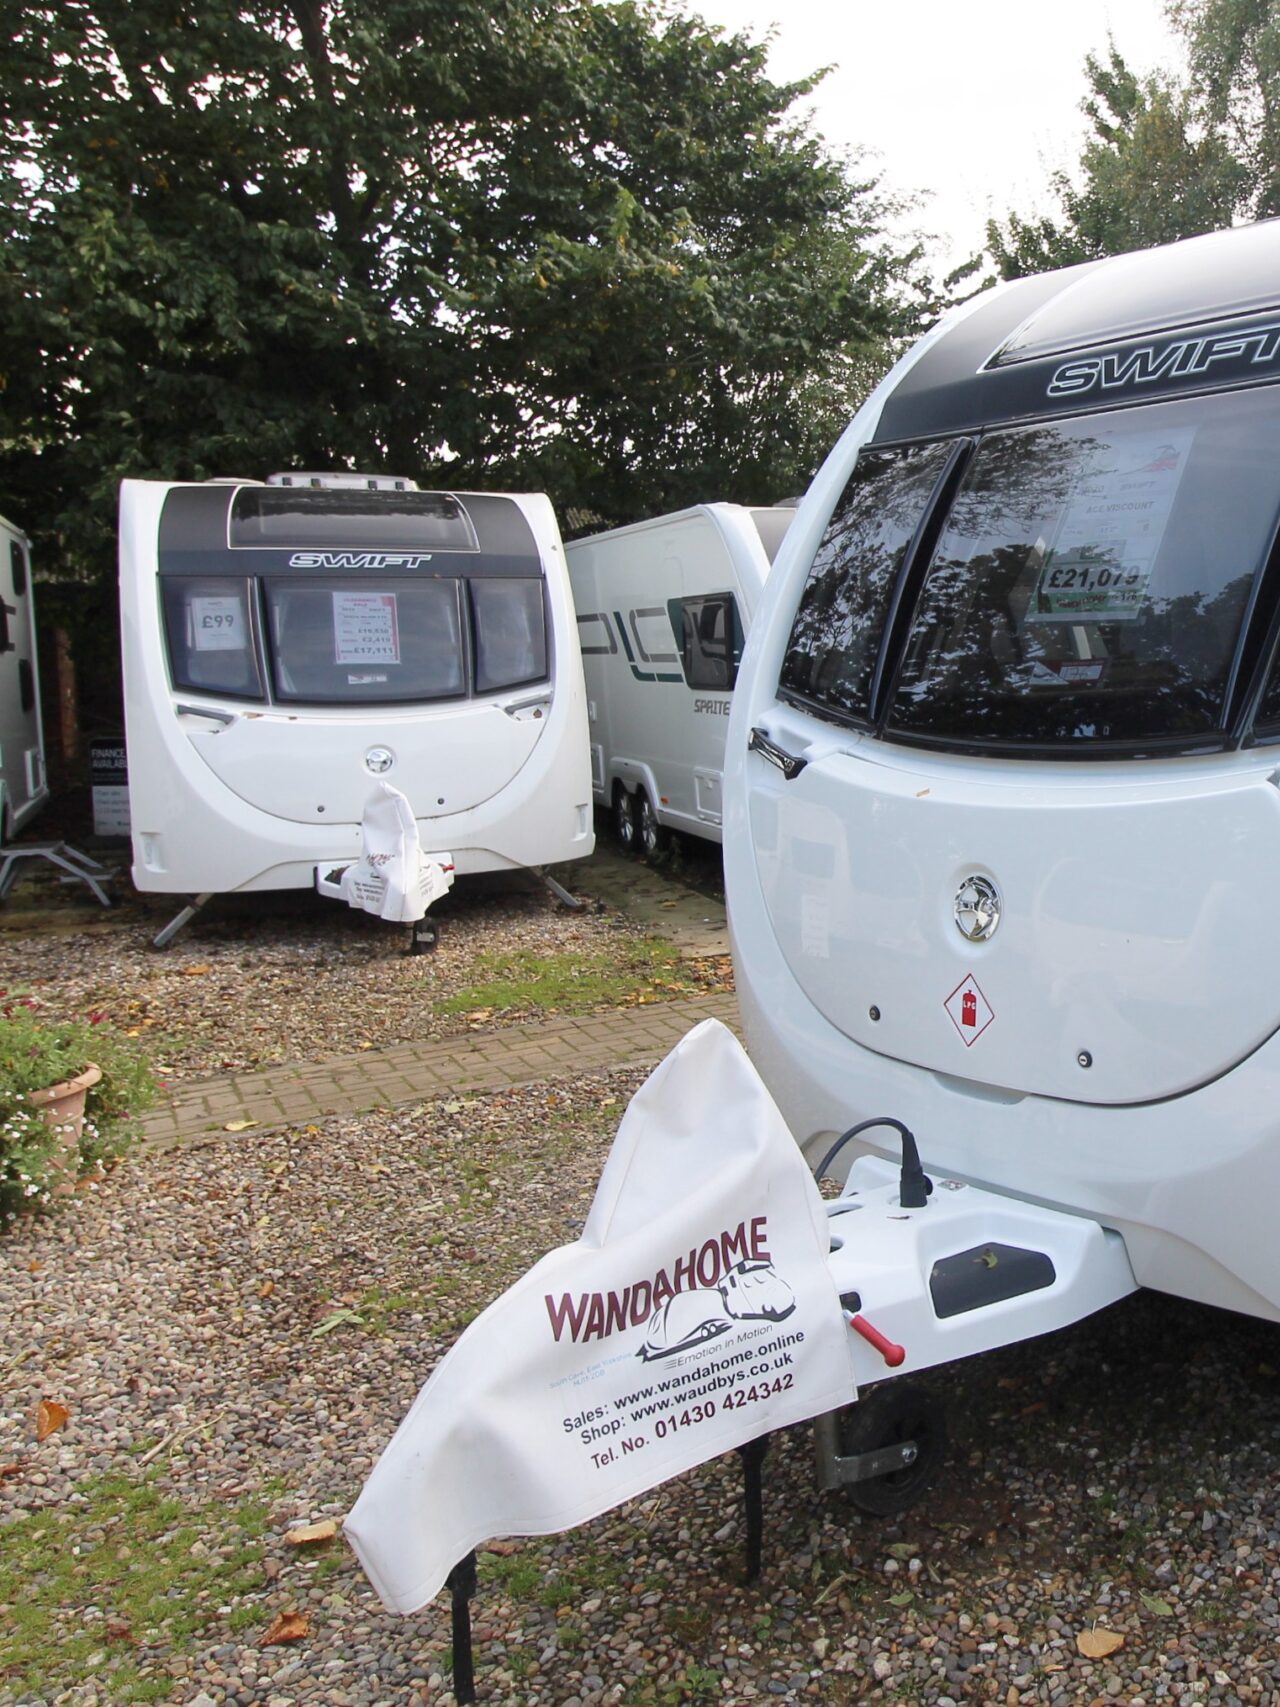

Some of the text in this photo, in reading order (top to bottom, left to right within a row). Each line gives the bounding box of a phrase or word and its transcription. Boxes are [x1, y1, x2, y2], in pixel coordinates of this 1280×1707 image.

[1106, 501, 1155, 512] VISCOUNT
[289, 553, 432, 568] SWIFT
[202, 614, 234, 629] £99
[694, 699, 731, 716] SPRITE
[91, 749, 126, 758] FINANCE
[544, 1216, 771, 1343] WANDAHOME
[677, 1323, 773, 1368] Emotion in Motion
[563, 1331, 805, 1433] Sales: www.wandahome.online
[580, 1352, 793, 1445] Shop: www.waudbys.co.uk
[591, 1373, 794, 1470] Tel. No. 01430 424342
